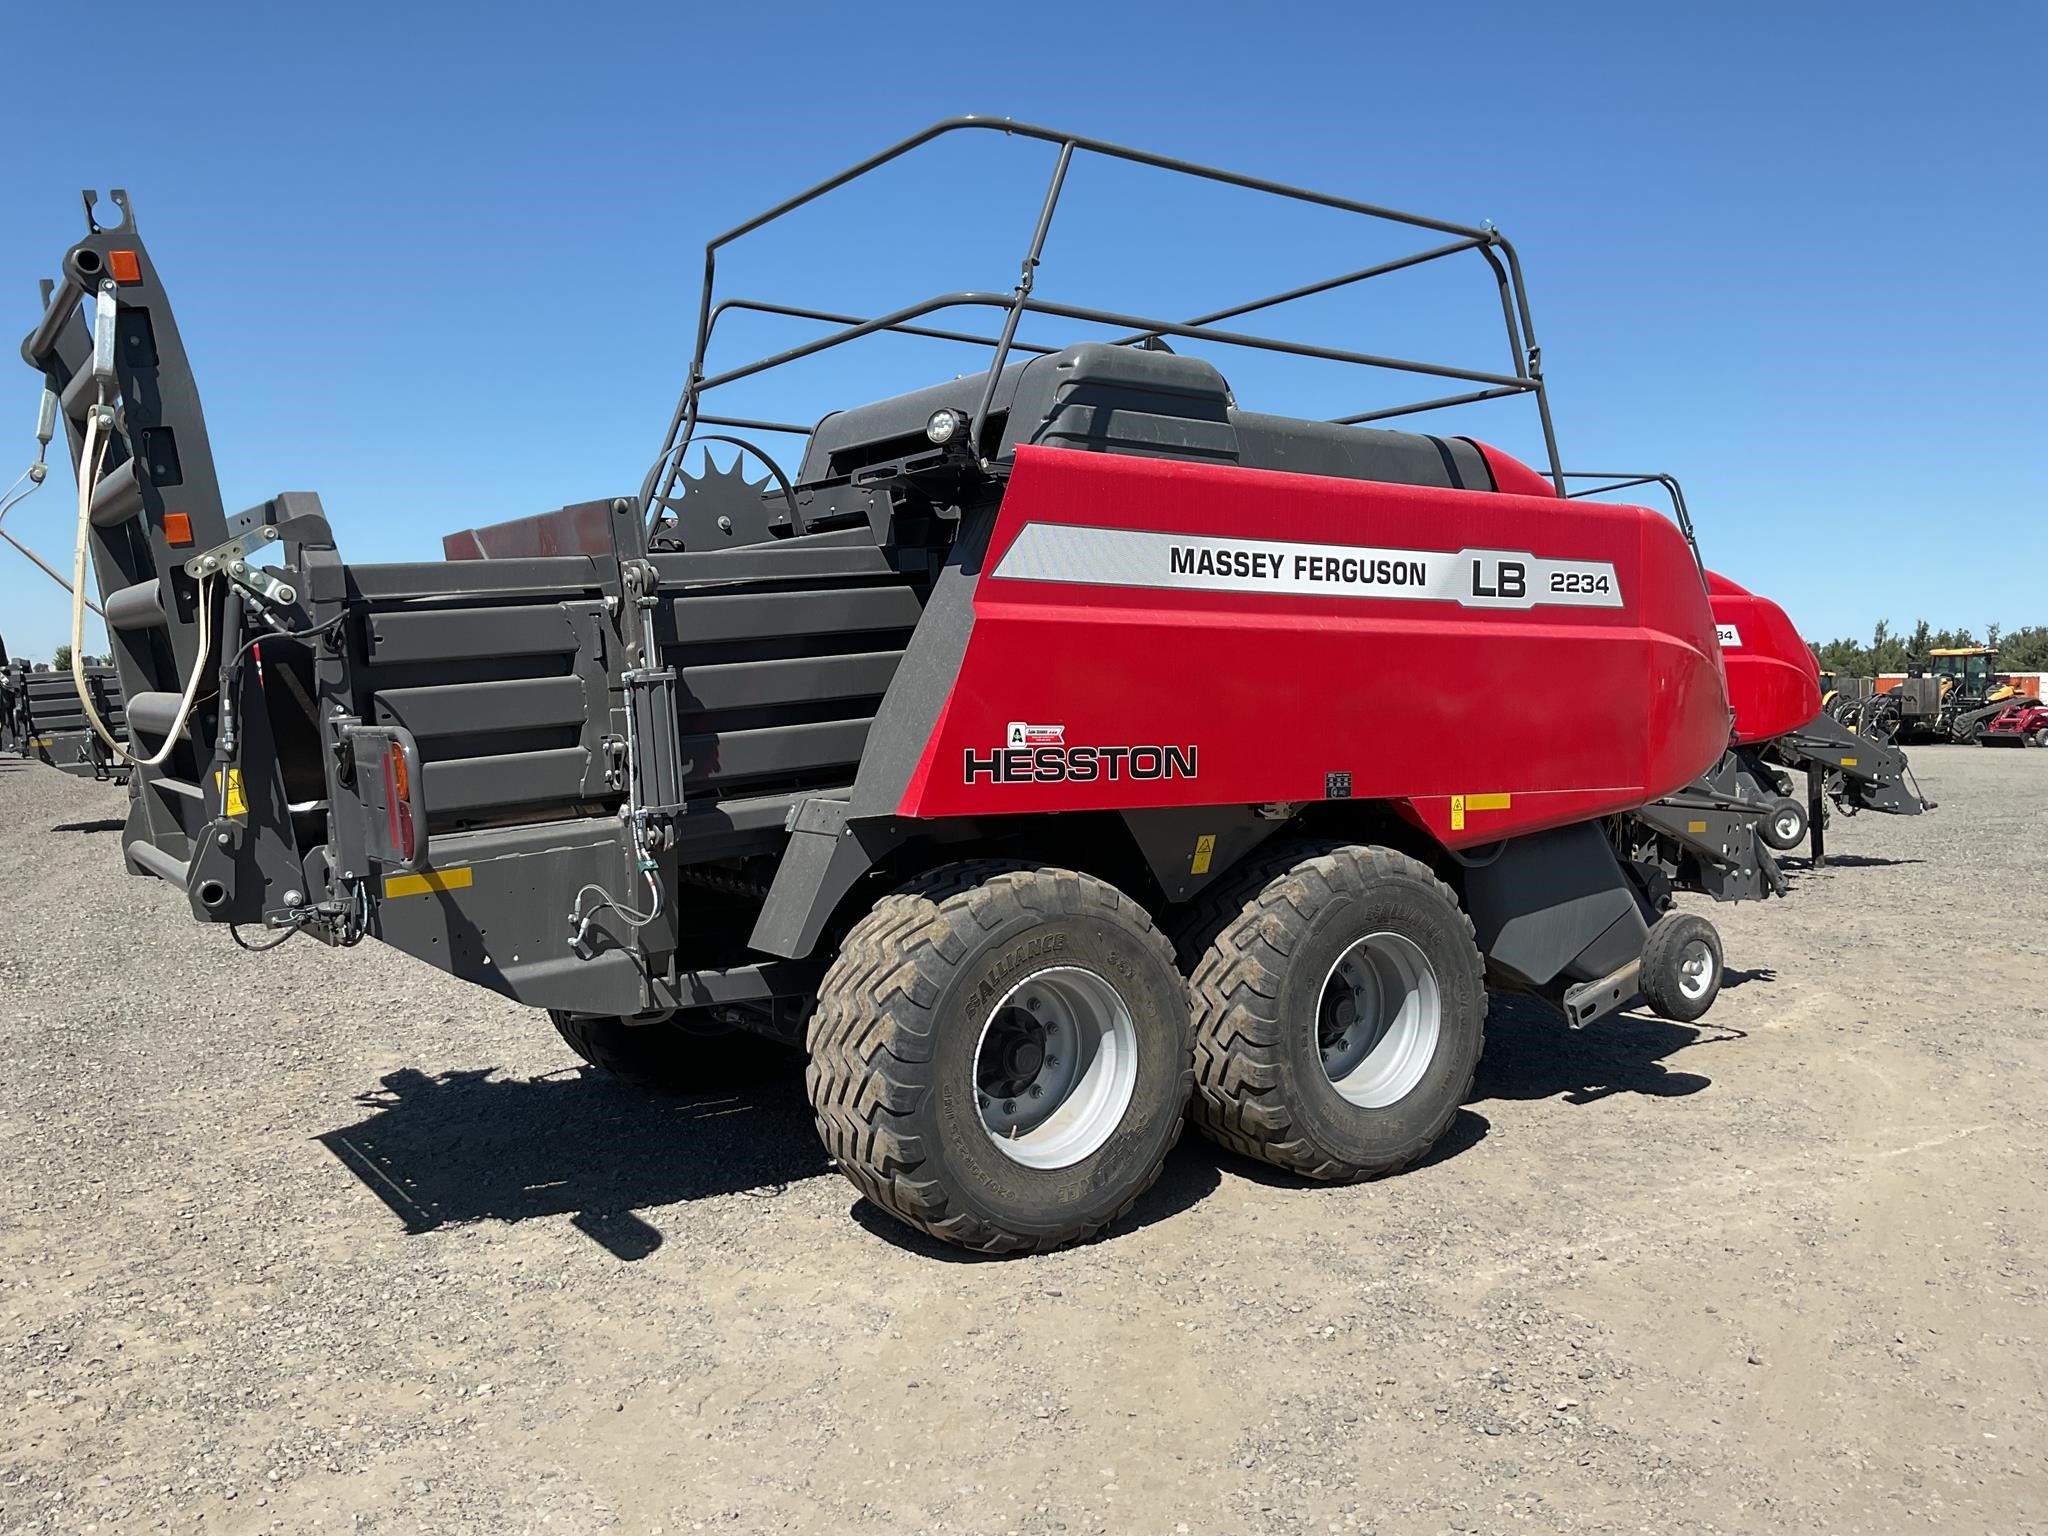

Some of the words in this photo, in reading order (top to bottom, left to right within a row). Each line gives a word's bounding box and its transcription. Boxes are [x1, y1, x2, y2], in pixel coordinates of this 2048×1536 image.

[1169, 546, 1285, 580] MASSEY
[1293, 555, 1427, 587] FERGUSON
[1471, 559, 1527, 599] LB
[1550, 572, 1611, 596] 2234
[964, 746, 1197, 784] HESSTON
[975, 932, 1065, 1006] ALLIANCE
